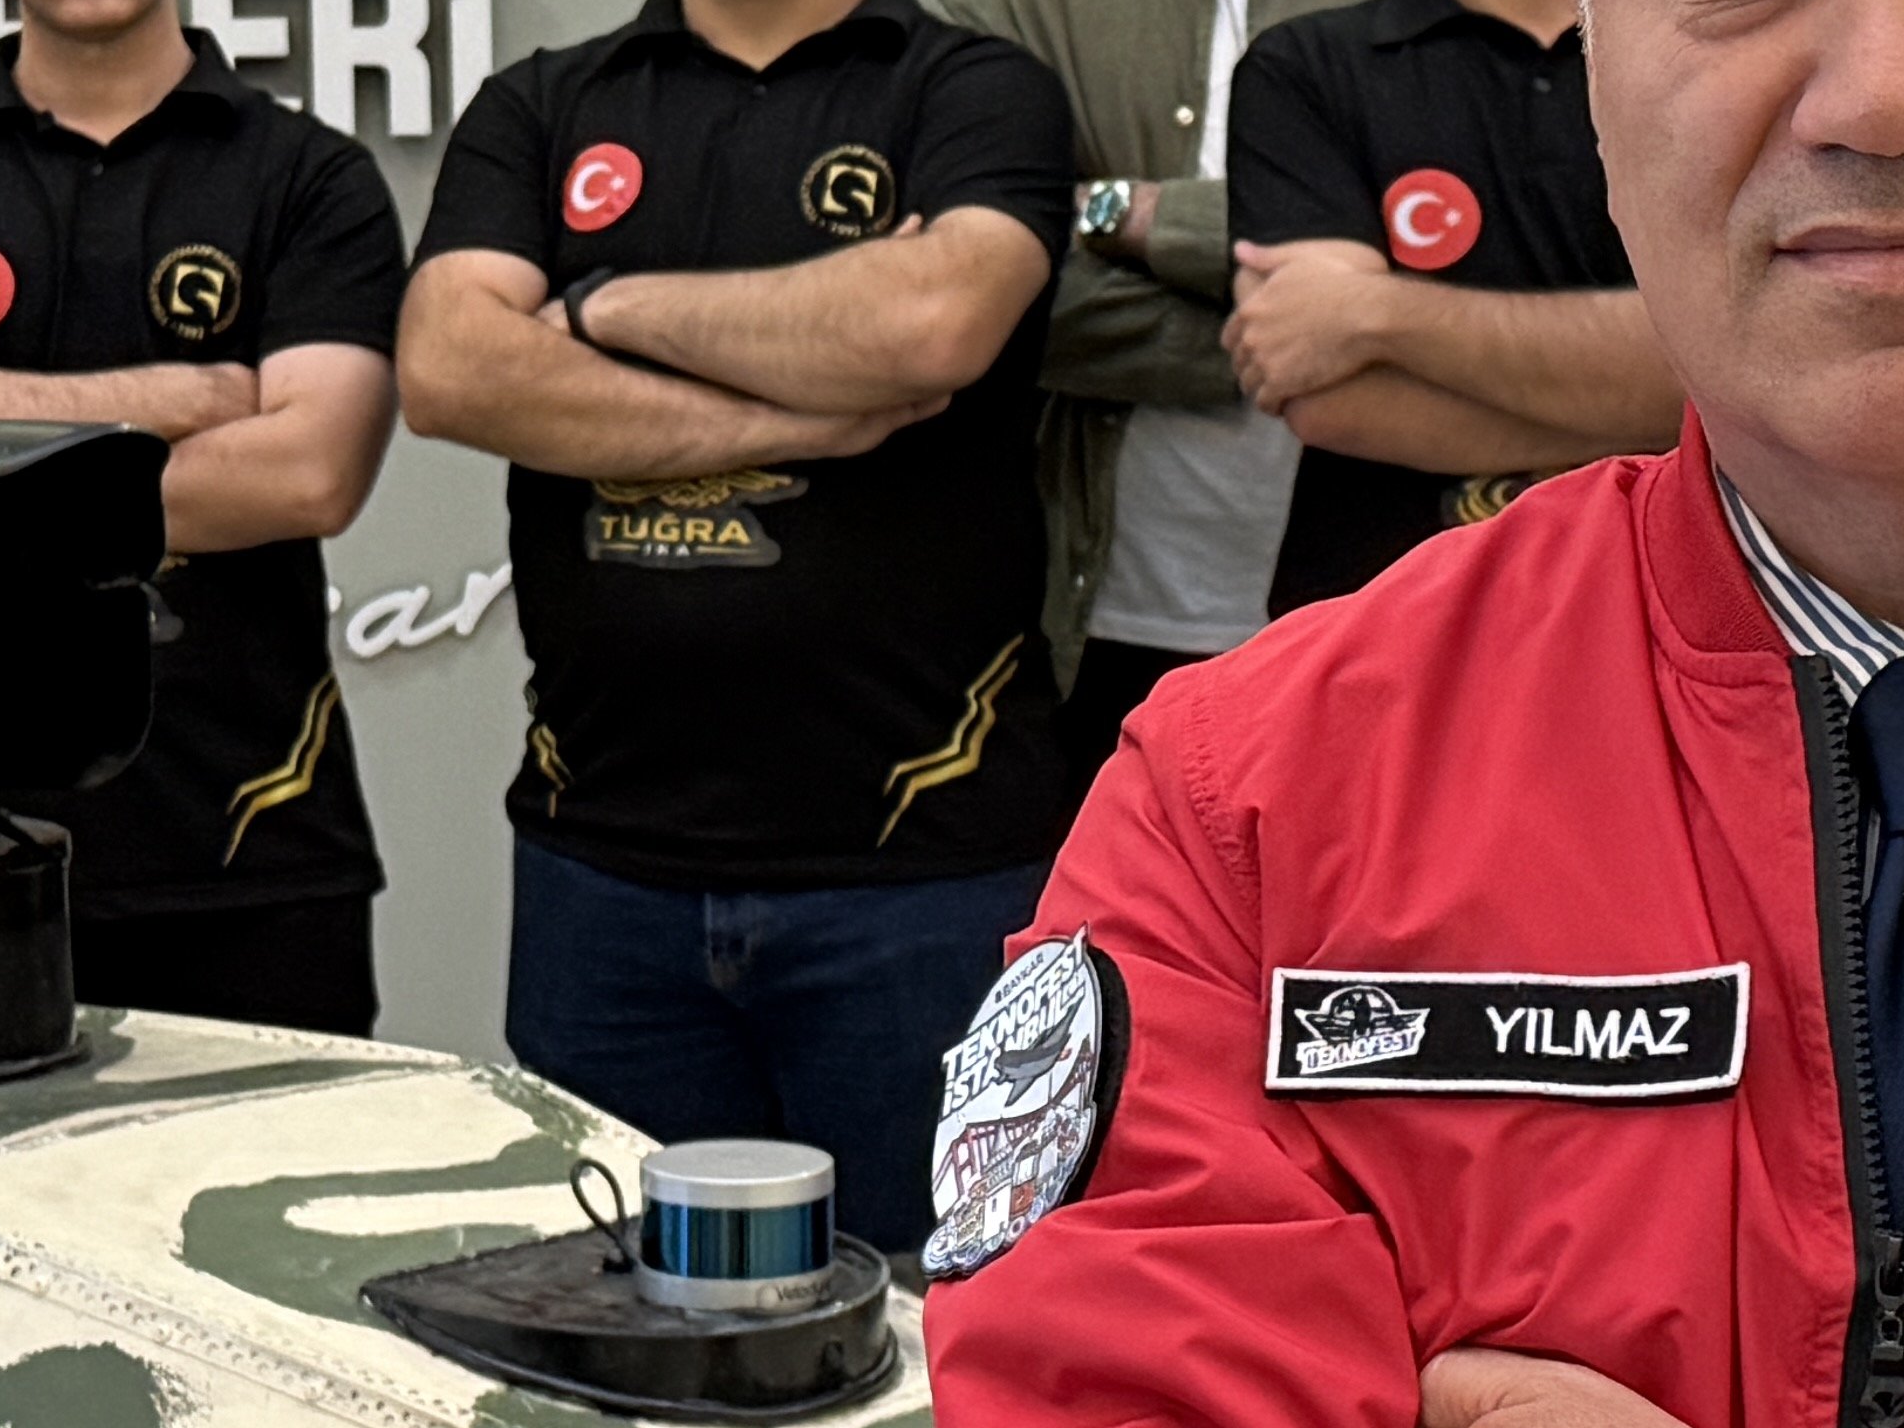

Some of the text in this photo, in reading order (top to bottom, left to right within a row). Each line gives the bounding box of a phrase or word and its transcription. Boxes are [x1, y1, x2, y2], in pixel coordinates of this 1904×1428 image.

[599, 511, 752, 545] TUĞRA
[942, 923, 1088, 1083] TEKNOFEST
[1304, 1027, 1417, 1071] TEKNOFEST
[1485, 1006, 1692, 1061] YILMAZ
